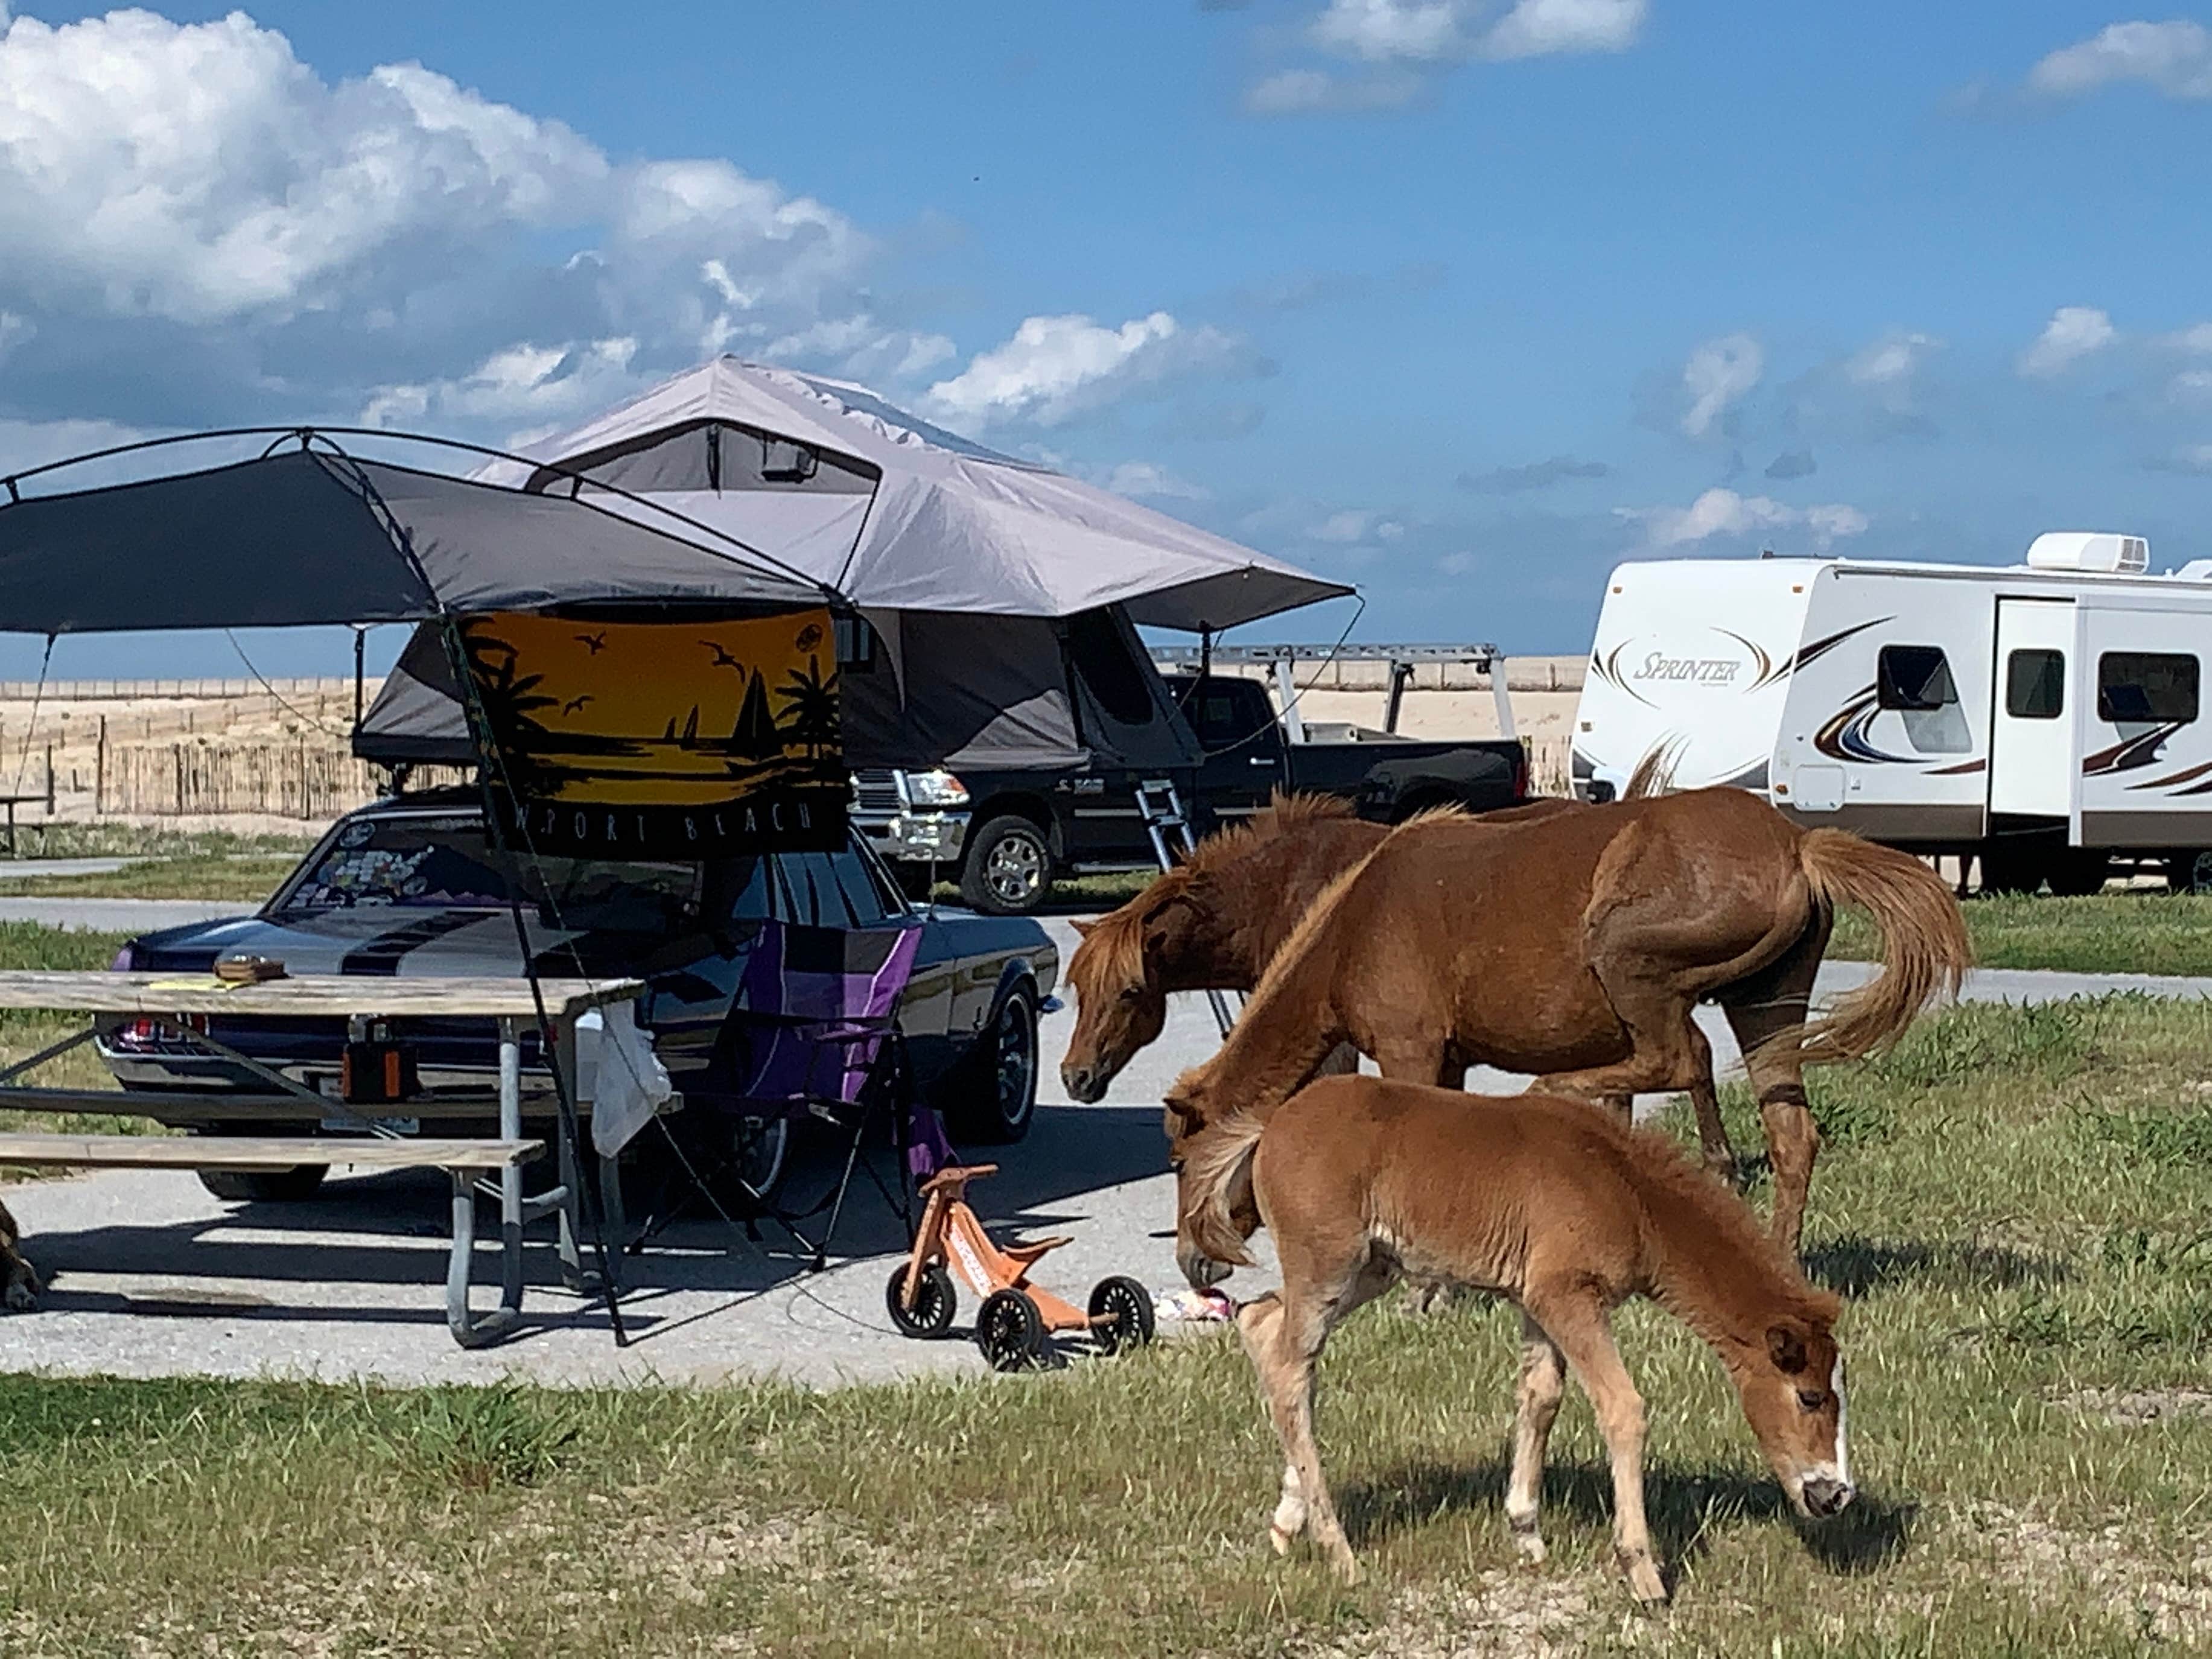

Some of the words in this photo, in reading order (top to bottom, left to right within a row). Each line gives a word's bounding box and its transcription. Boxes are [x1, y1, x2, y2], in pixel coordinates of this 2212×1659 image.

[1633, 652, 1741, 680] SPRINTER
[515, 803, 645, 843] WPORT
[685, 802, 812, 840] BEACH
